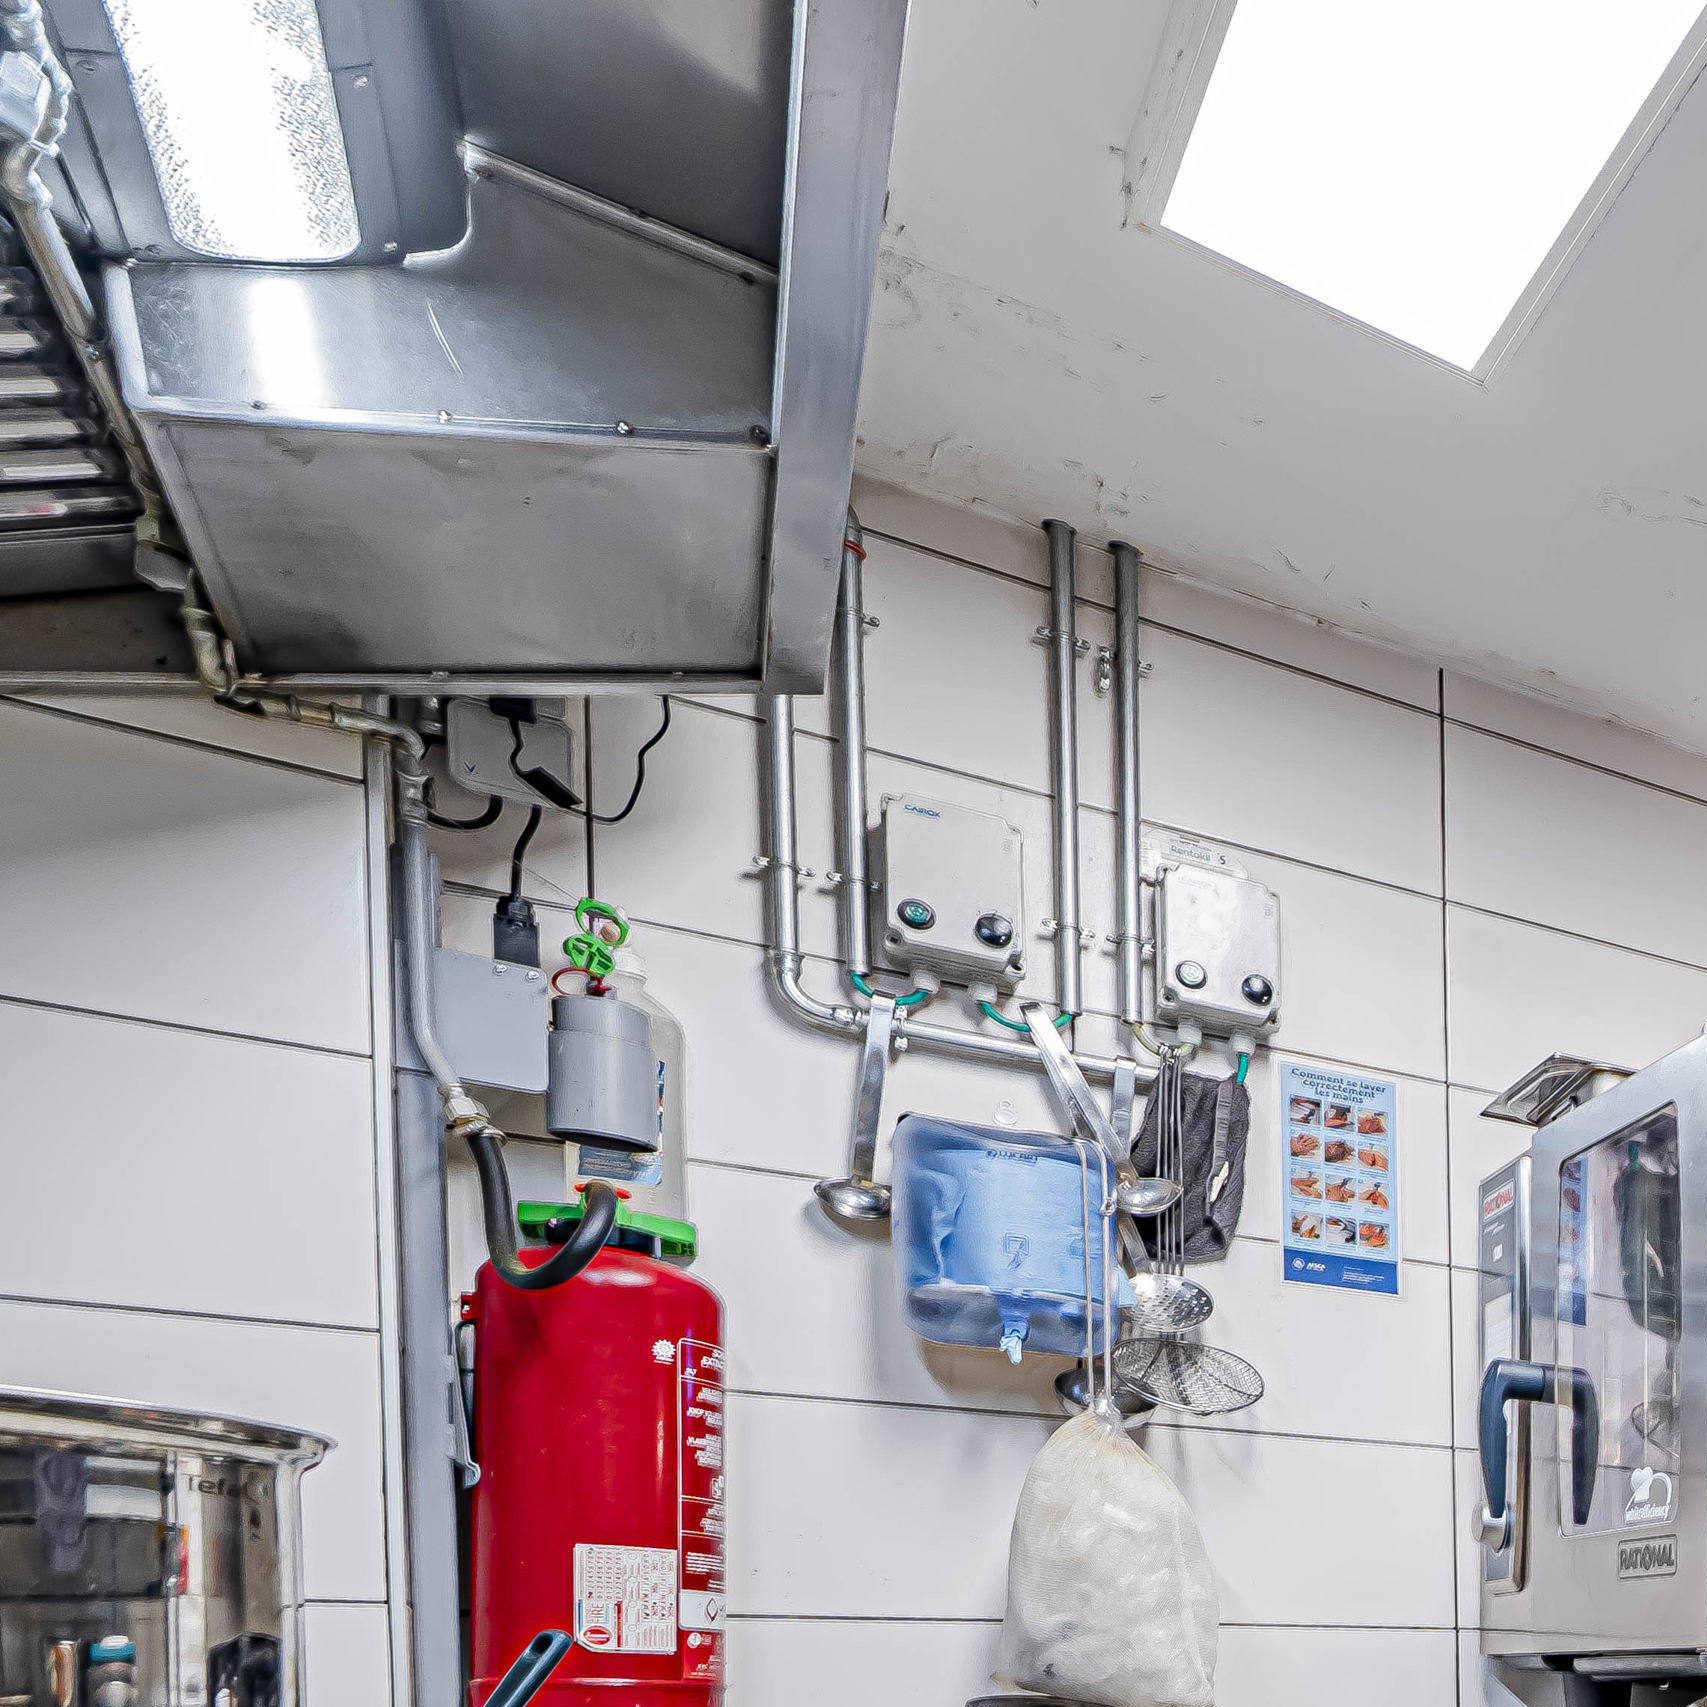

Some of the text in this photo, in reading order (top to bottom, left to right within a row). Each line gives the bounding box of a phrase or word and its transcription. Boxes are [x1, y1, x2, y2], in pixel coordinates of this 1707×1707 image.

[904, 804, 941, 818] CAIROX
[1170, 845, 1211, 862] Rentokil
[1291, 1068, 1386, 1093] Comment se laver
[1303, 1079, 1375, 1098] correctement
[1315, 1087, 1364, 1104] les mains
[1484, 1185, 1513, 1216] RATIONAL
[1620, 1543, 1675, 1571] RATIONAL
